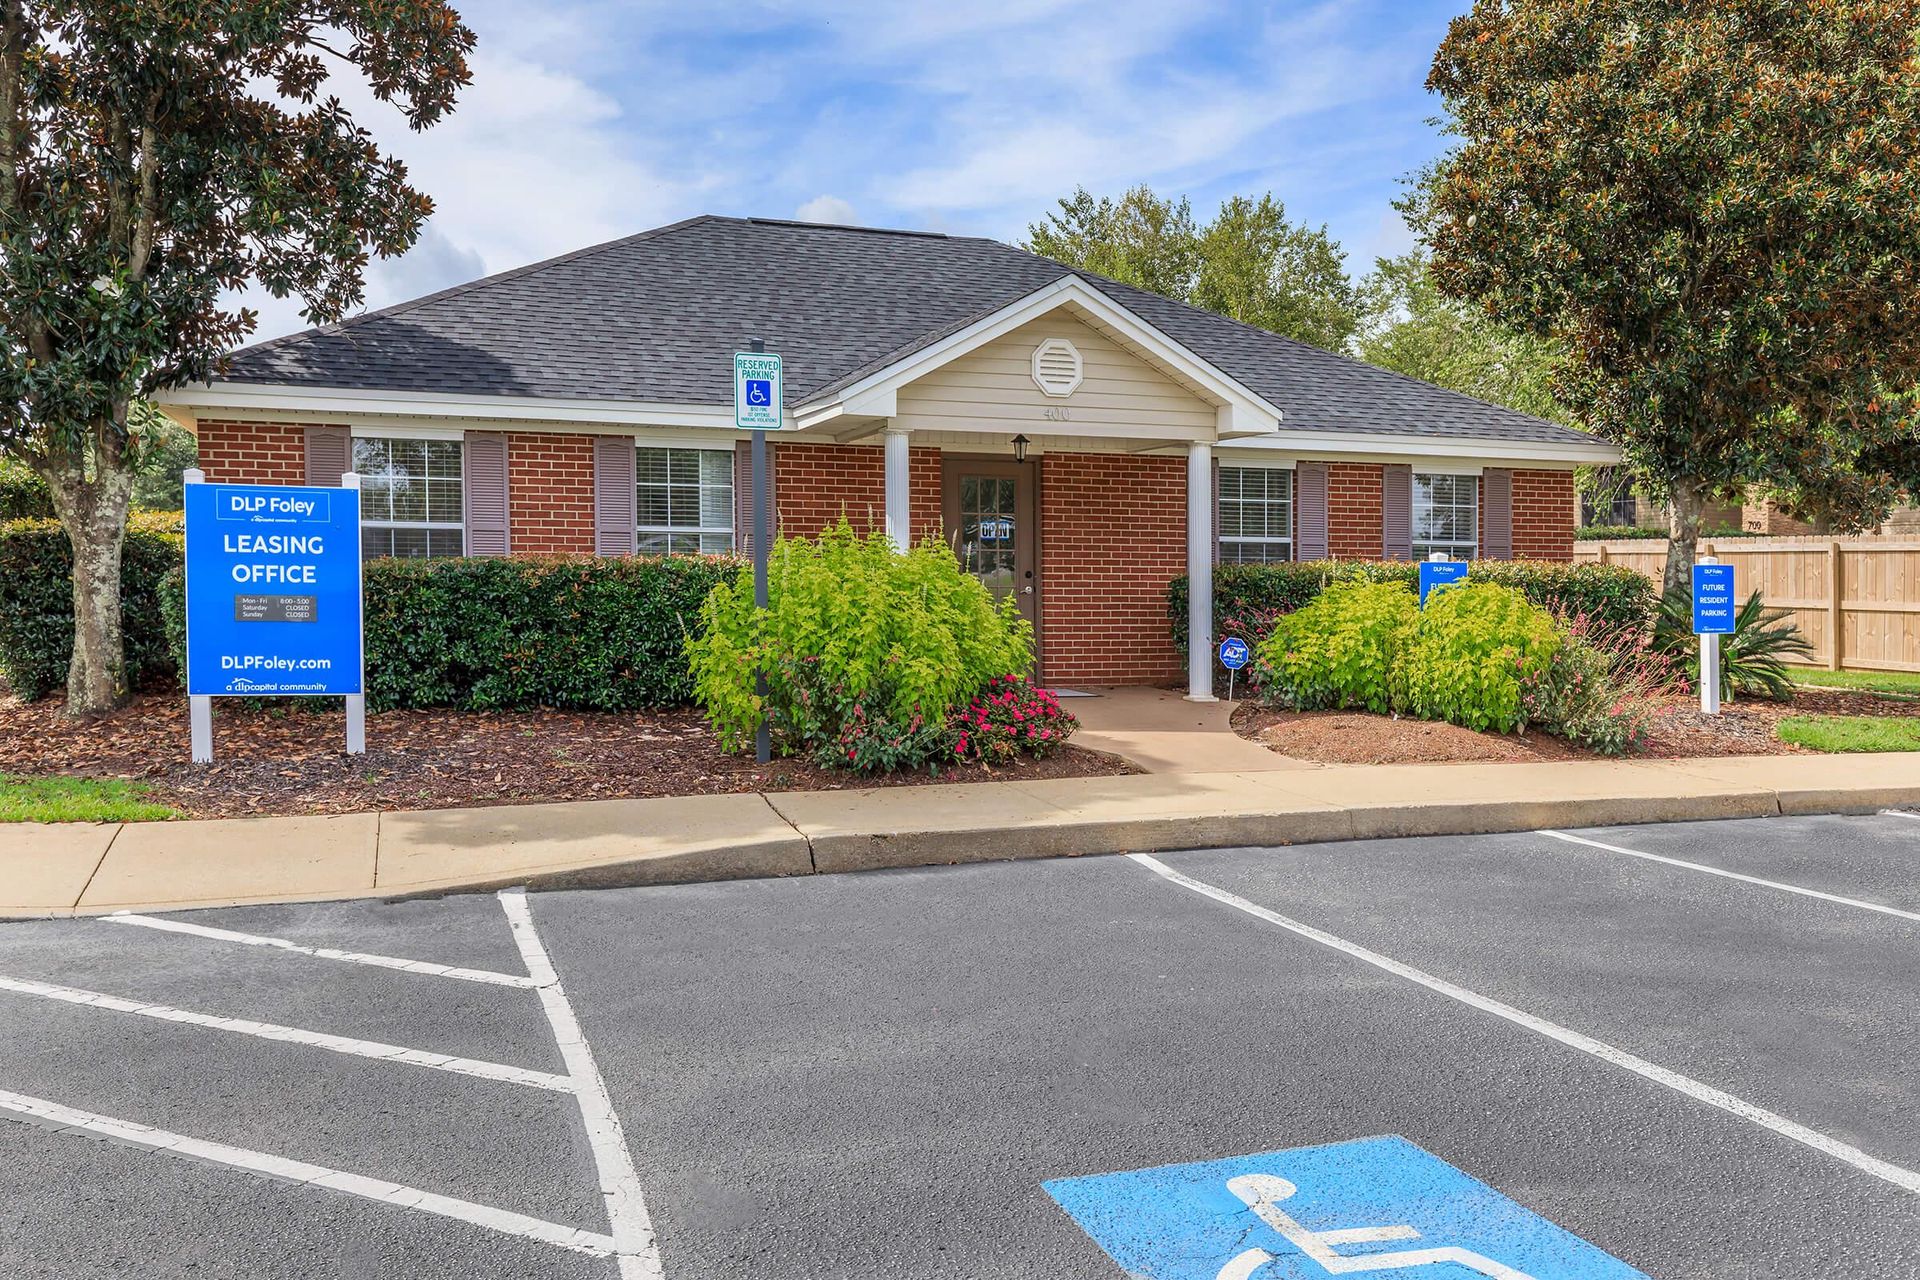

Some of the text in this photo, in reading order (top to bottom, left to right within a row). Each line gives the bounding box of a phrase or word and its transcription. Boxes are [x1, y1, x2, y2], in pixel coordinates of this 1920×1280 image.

[738, 360, 779, 371] RESERVED
[742, 370, 775, 380] PARKING
[1041, 407, 1071, 422] 400
[231, 496, 315, 516] DLP Foley
[1748, 520, 1762, 530] 700
[223, 534, 324, 555] LEASING
[231, 564, 317, 584] OFFICE
[1699, 596, 1729, 604] RESIDENT
[1701, 609, 1727, 617] PARKING
[1224, 646, 1246, 660] ADT
[221, 655, 331, 672] DLPFoley.com
[280, 682, 327, 692] community
